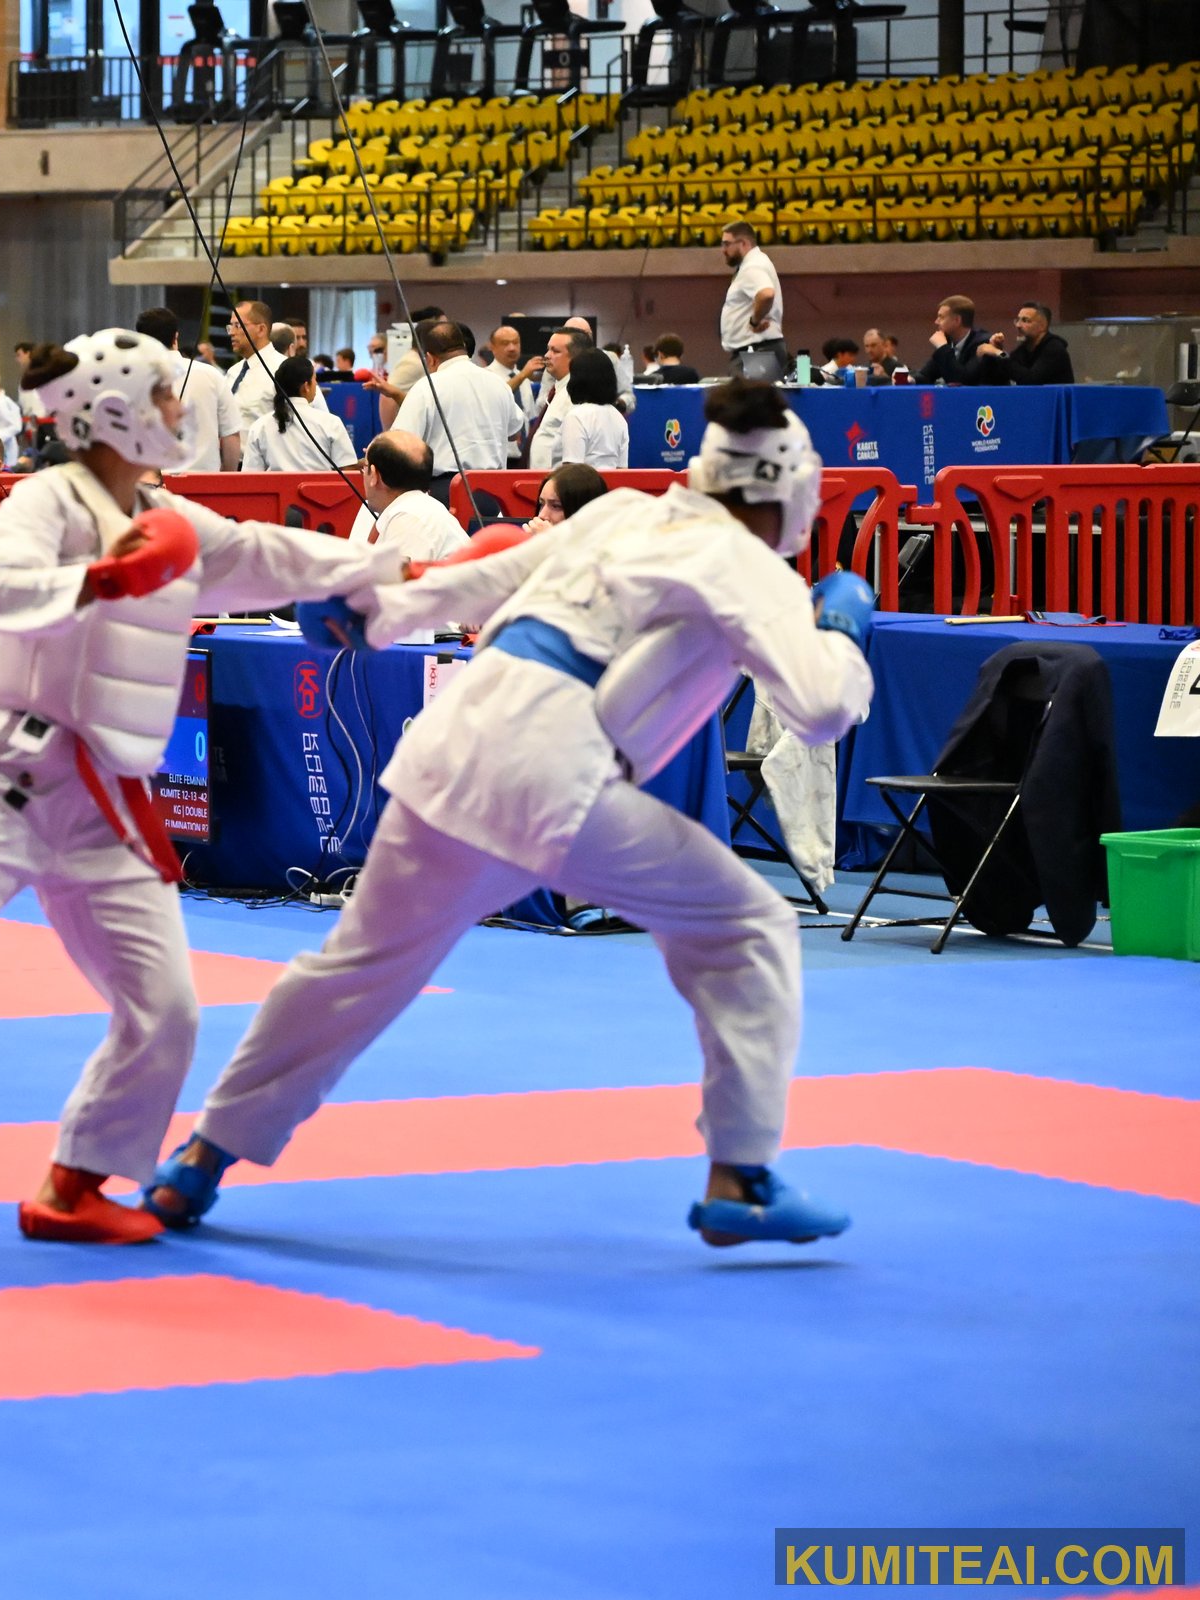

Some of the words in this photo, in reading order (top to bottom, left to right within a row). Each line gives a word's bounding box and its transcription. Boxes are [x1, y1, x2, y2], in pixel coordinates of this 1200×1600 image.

[194, 731, 206, 762] 0
[160, 787, 180, 799] KUMITE
[182, 790, 197, 802] 12-13
[173, 804, 181, 815] KG
[185, 806, 208, 818] DOUBLE
